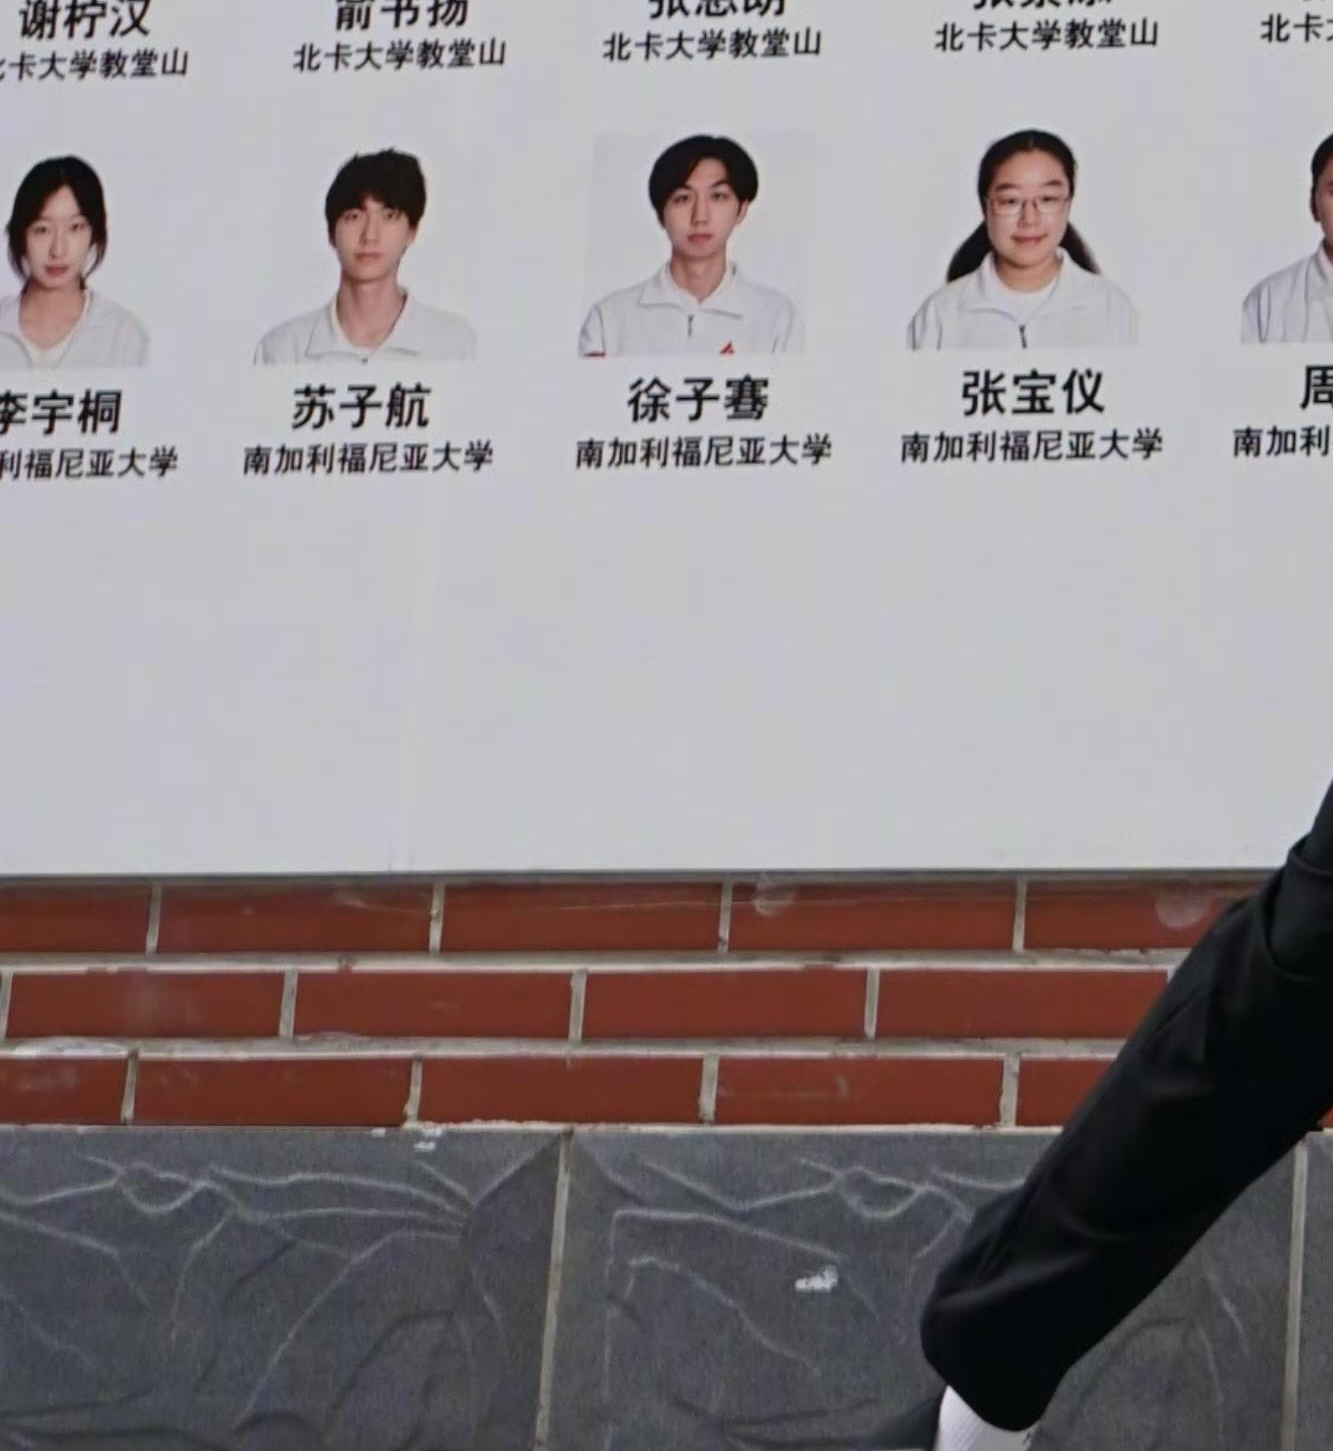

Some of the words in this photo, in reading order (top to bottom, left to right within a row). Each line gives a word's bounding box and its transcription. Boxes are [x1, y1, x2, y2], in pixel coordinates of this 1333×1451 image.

[602, 26, 822, 62] 北卡大学教堂山
[934, 17, 1159, 53] 北卡大学教堂山
[293, 37, 506, 73] 北卡大学教堂山
[291, 381, 432, 431] 苏子航
[626, 373, 769, 424] 徐子骞
[961, 367, 1105, 418] 张宝仪
[243, 439, 494, 476] 南加利福尼亚大学
[575, 432, 832, 470] 南加利福尼亚大学
[901, 427, 1163, 464] 南加利福尼亚大学
